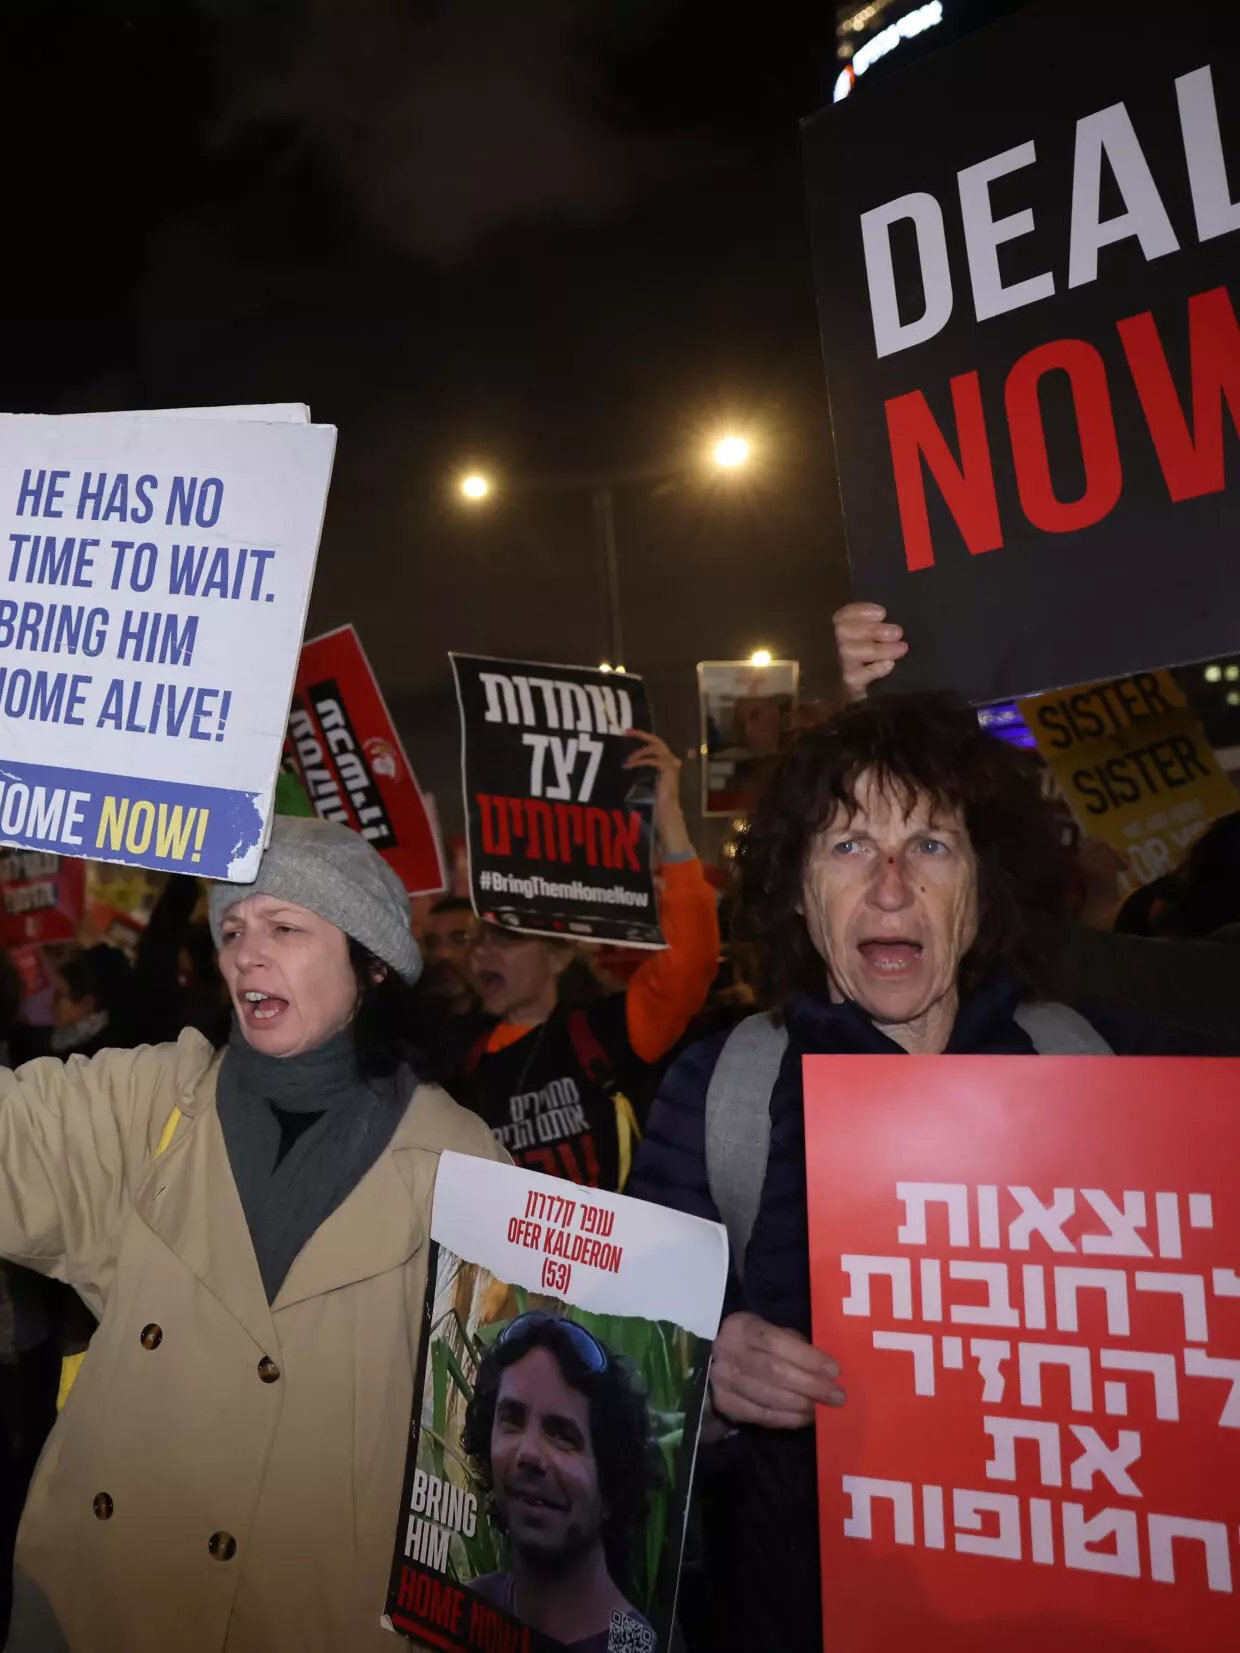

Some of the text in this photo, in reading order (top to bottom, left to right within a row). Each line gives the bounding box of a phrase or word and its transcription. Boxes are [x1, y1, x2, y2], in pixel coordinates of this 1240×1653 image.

[860, 64, 1240, 359] DEAL
[884, 286, 1240, 572] NOW
[16, 469, 225, 528] HE HAS NO
[7, 534, 276, 602] TIME TO WAIT.
[118, 609, 200, 666] HIM
[97, 680, 233, 742] ALIVE!
[479, 672, 632, 736] עומדות
[1038, 673, 1172, 749] SISTER
[522, 733, 604, 802] לצד
[1072, 734, 1211, 815] SISTER
[96, 796, 210, 863] NOW!
[476, 794, 642, 872] אחיותינו
[480, 871, 648, 907] #BringThemHomeNow
[507, 1217, 624, 1274] OFER KALDERON
[524, 1190, 615, 1238] עופר קלדרון
[896, 1182, 1214, 1258] יוצאות
[542, 1257, 571, 1294] (53)
[983, 1415, 1143, 1497] את
[411, 1468, 478, 1538] BRING
[842, 1474, 1233, 1594] חטופות
[404, 1515, 451, 1574] HIM
[398, 1565, 466, 1633] HOME
